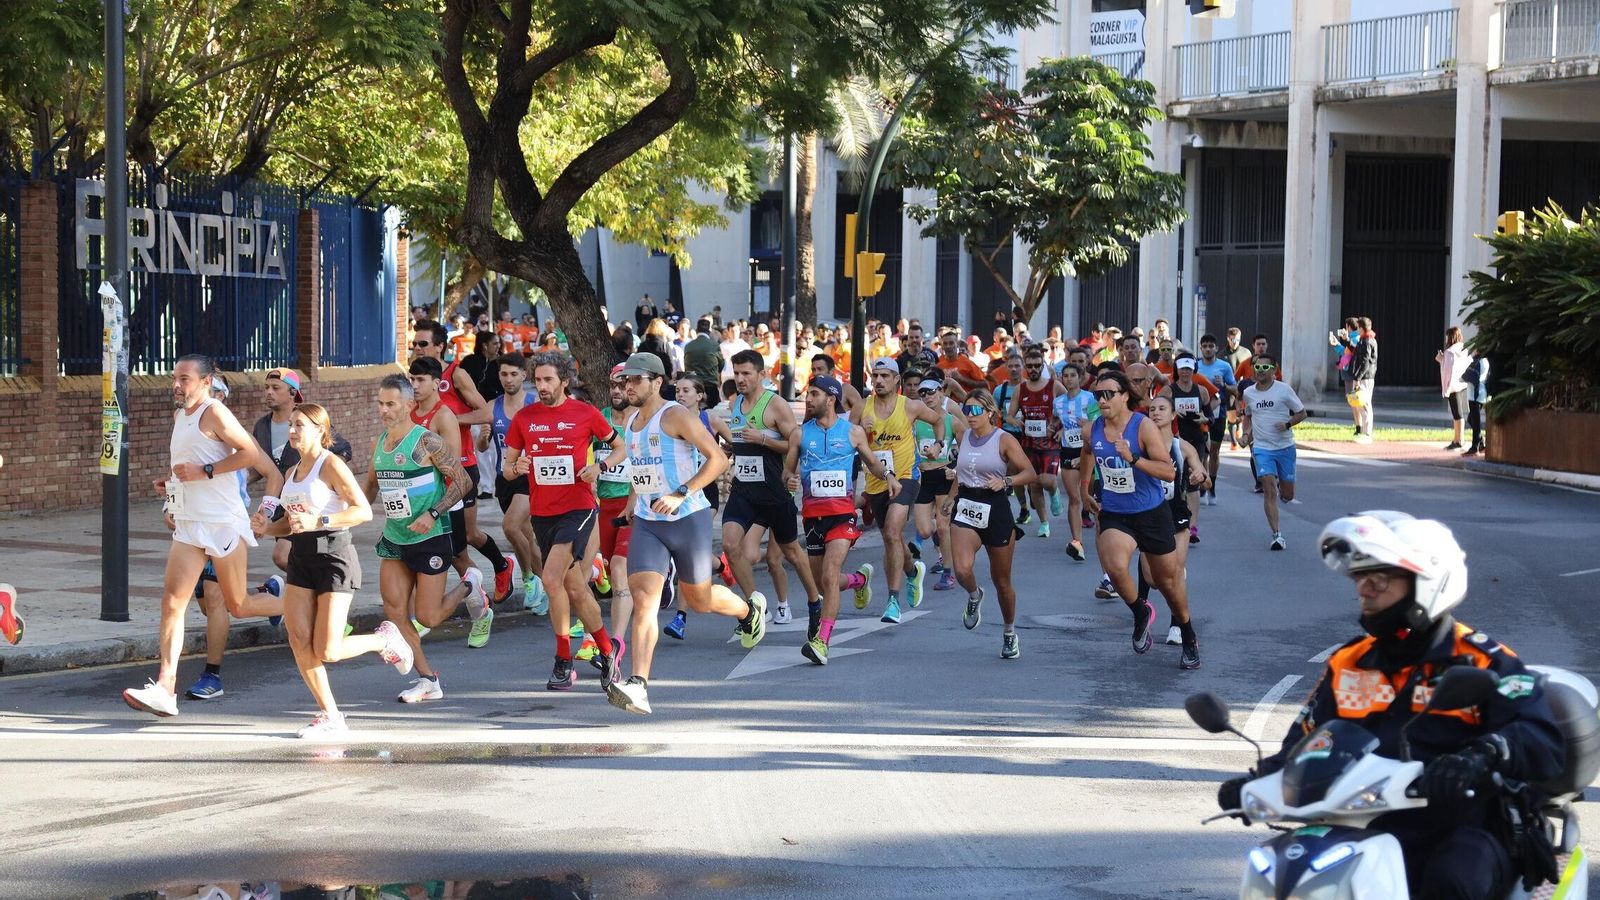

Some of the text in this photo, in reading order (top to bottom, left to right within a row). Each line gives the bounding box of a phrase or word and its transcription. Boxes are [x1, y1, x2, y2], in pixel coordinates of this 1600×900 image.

[1124, 19, 1138, 31] VIP
[1090, 32, 1137, 46] MALAGUISTA
[1256, 400, 1274, 409] nike
[540, 466, 567, 476] 573
[738, 465, 758, 474] 754
[633, 475, 651, 485] 947
[816, 480, 844, 488] 1030
[1106, 475, 1128, 486] 752
[384, 500, 404, 511] 365
[962, 508, 983, 520] 464
